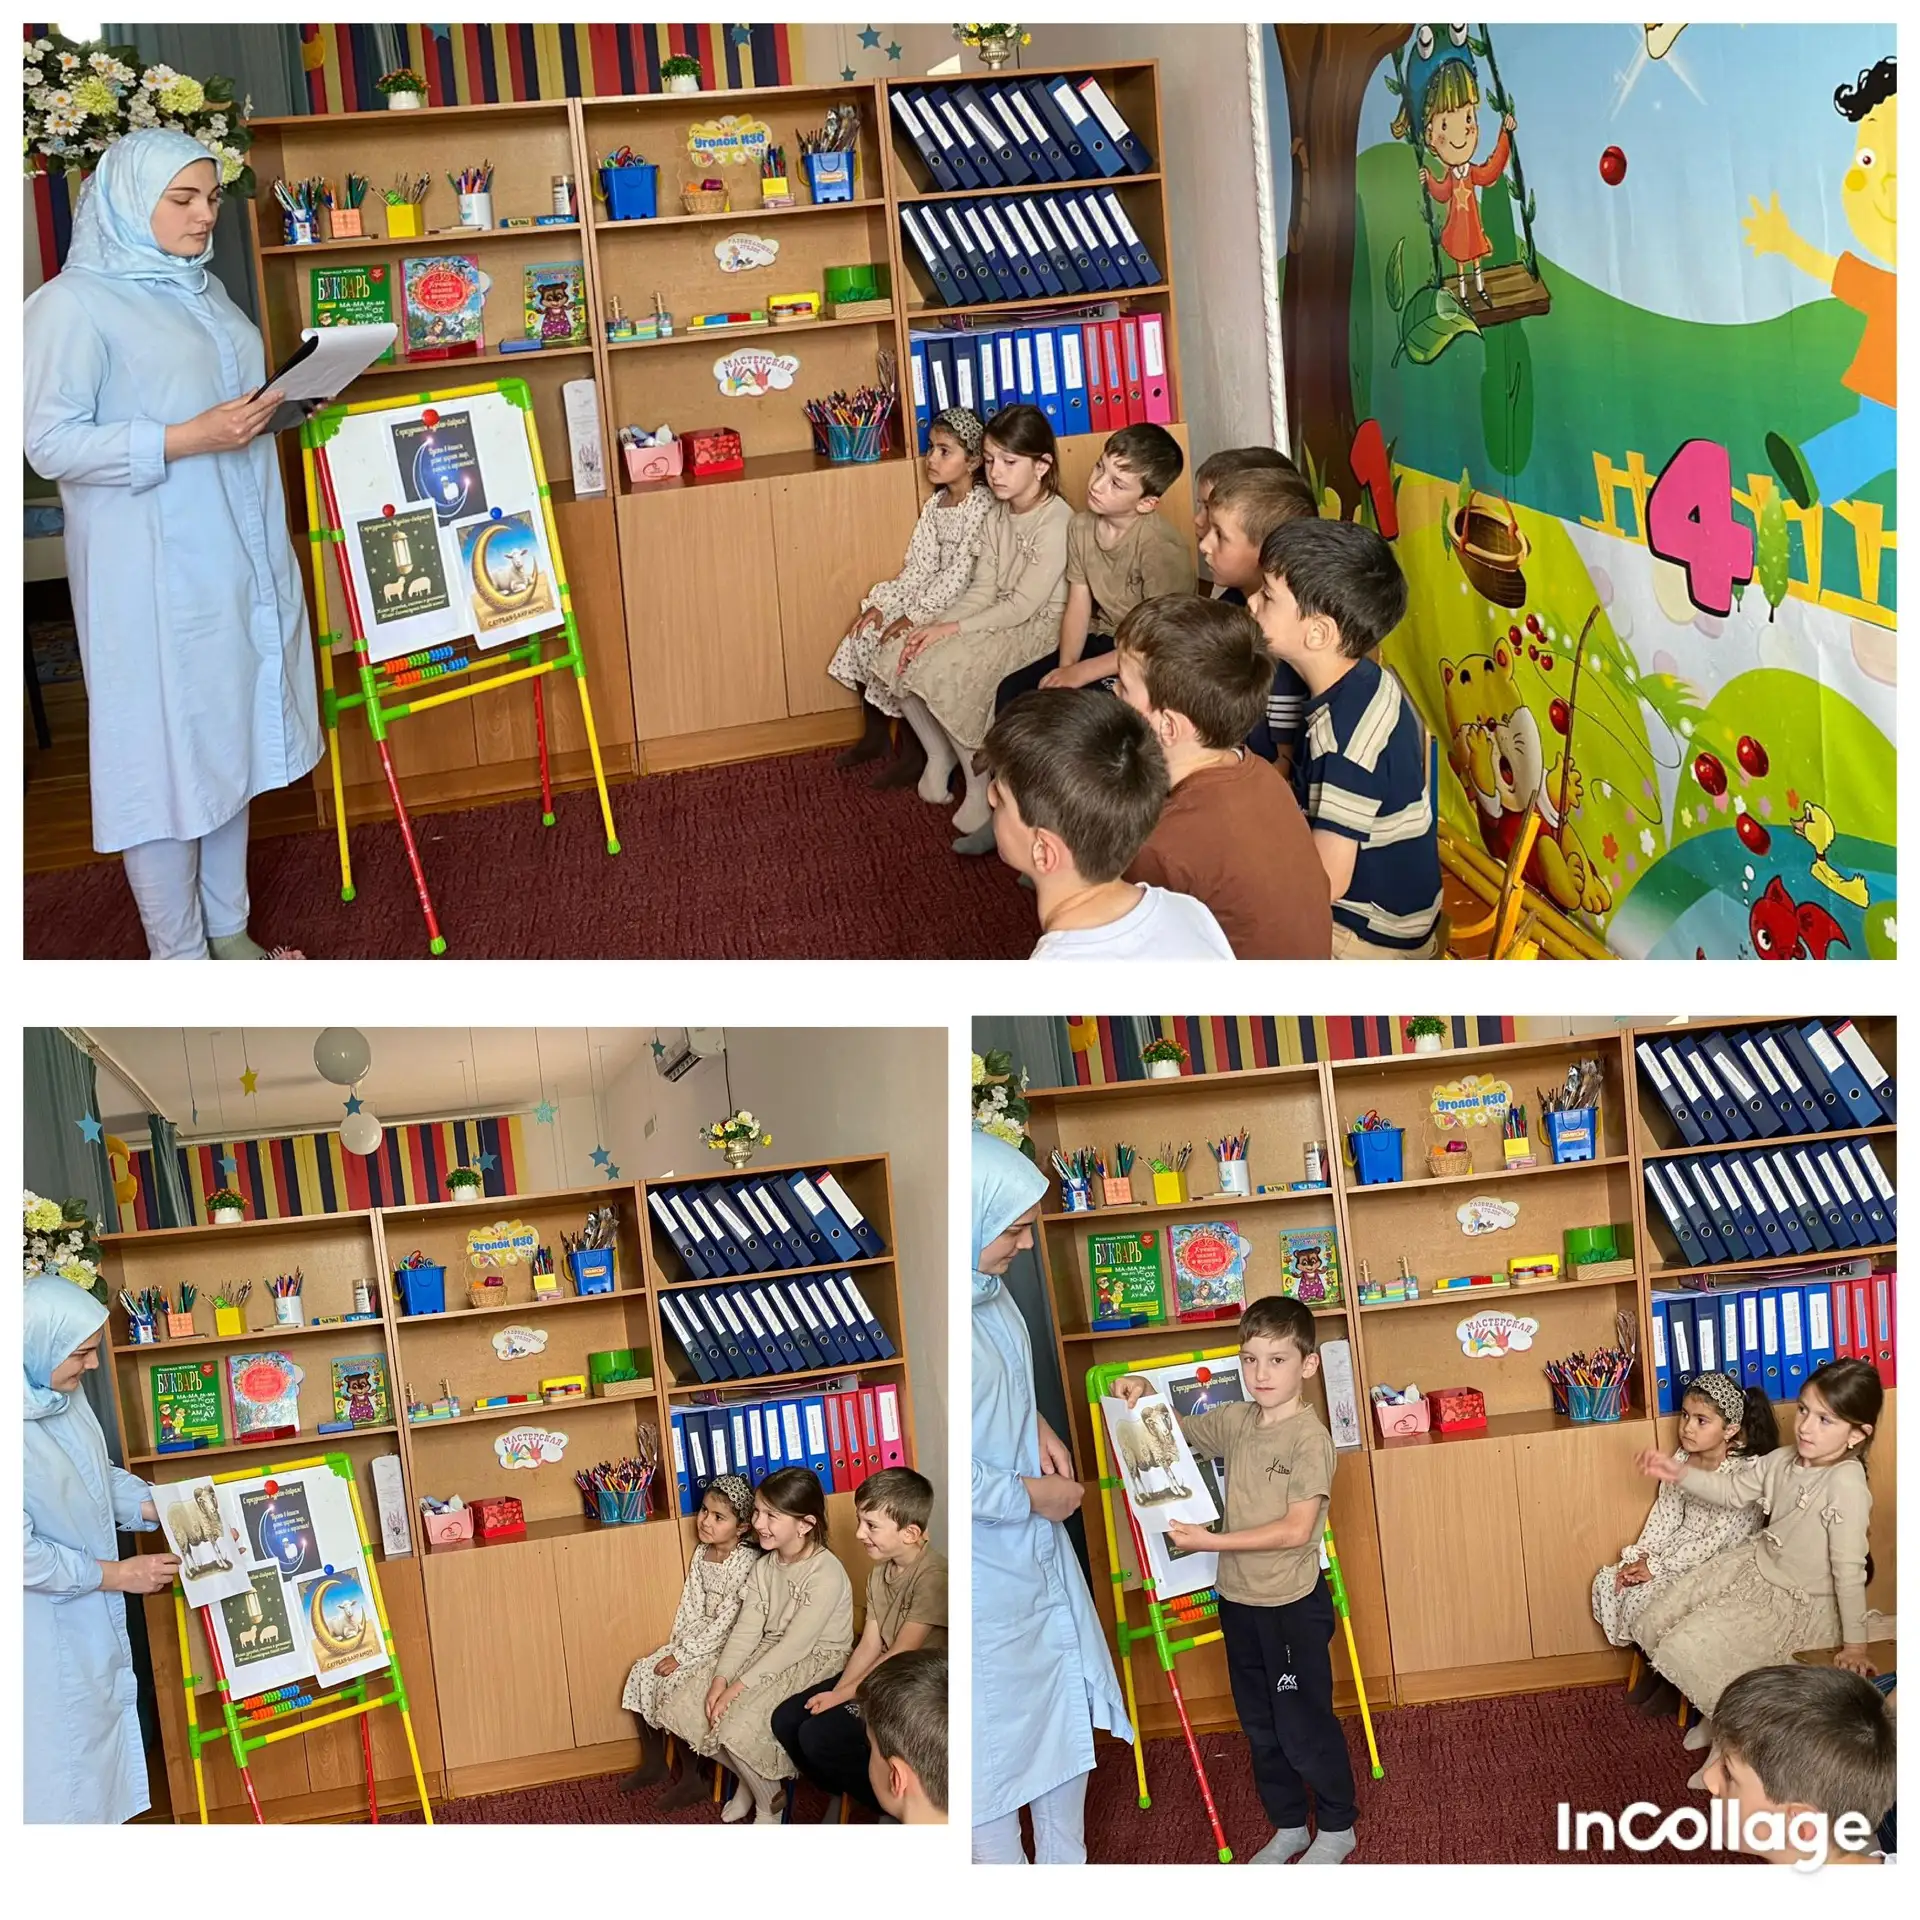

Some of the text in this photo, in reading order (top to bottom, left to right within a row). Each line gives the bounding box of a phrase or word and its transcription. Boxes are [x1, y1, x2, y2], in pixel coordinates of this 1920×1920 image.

[695, 132, 765, 148] Уголок ИЗО
[318, 274, 370, 300] БУКВАРЬ
[723, 356, 794, 371] МАСТЕРСКАЯ
[1645, 438, 1754, 618] 4
[1438, 1092, 1506, 1110] Уголок ИЗО
[473, 1235, 534, 1251] Уголок ИЗО
[1094, 1241, 1142, 1265] БУКВАРЬ
[1144, 1285, 1155, 1293] АУ
[1466, 1318, 1533, 1333] МАСТЕРСКАЯ
[157, 1371, 202, 1393] БУКВАРЬ
[502, 1433, 563, 1446] МАСТЕРСКАЯ
